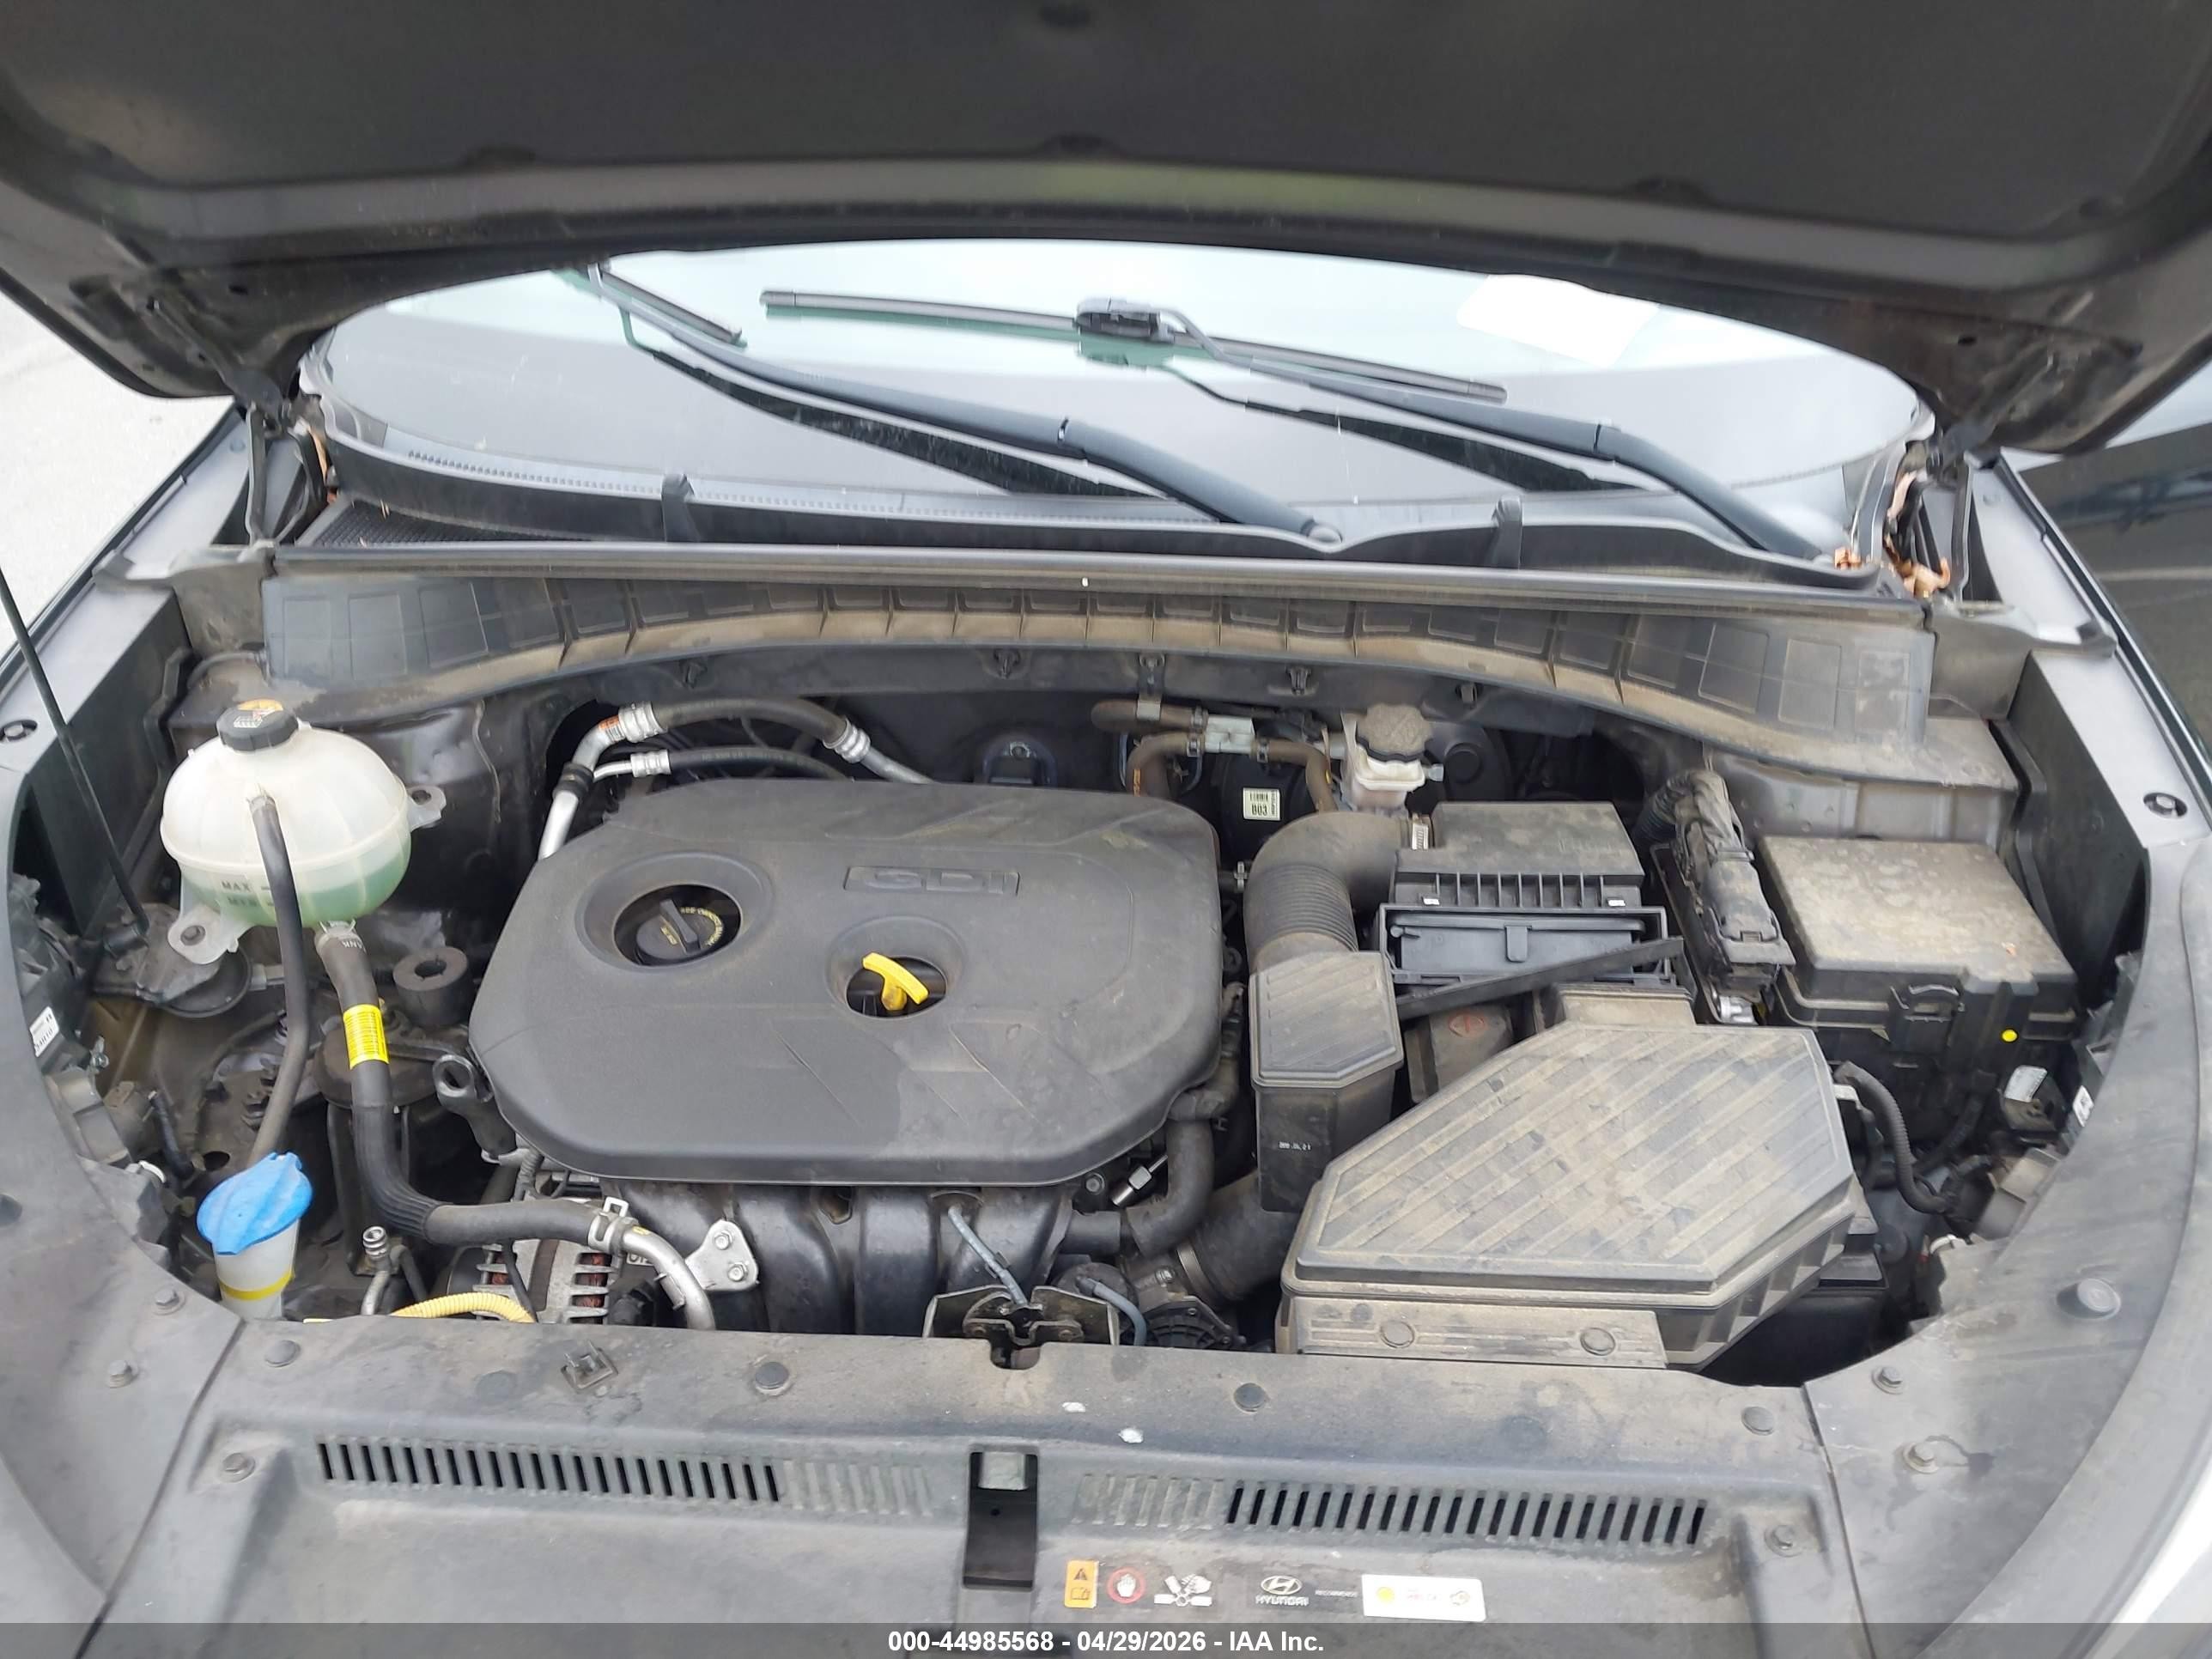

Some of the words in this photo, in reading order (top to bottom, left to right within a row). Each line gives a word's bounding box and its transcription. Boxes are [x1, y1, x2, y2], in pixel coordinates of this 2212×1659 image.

[1251, 804, 1267, 816] B03
[221, 880, 251, 892] MAX
[864, 869, 1005, 894] GDI
[1255, 1595, 1310, 1607] HYUNDAI
